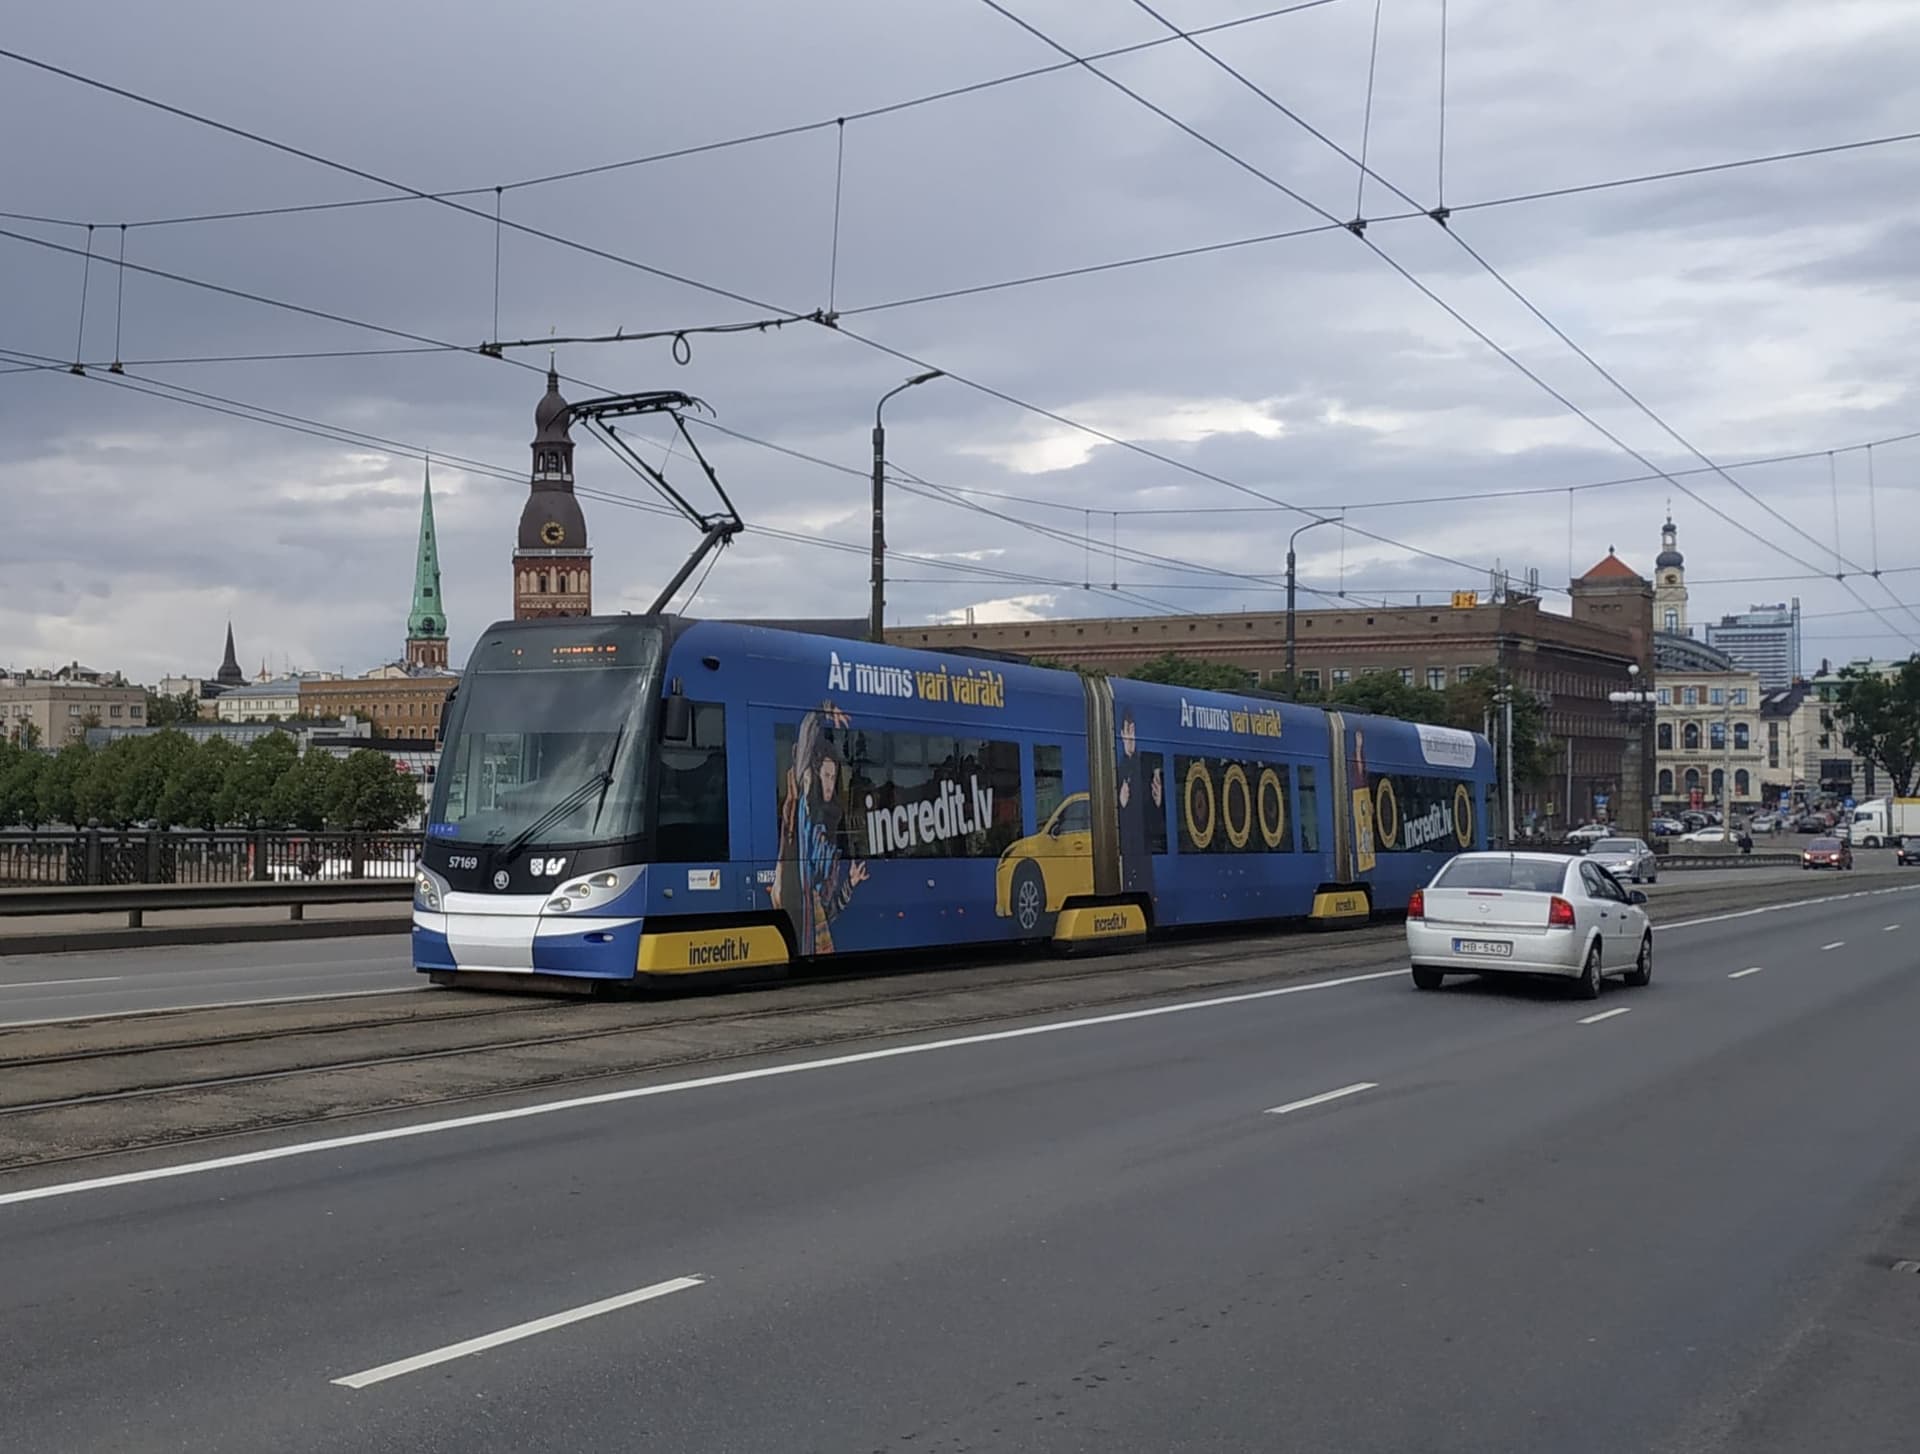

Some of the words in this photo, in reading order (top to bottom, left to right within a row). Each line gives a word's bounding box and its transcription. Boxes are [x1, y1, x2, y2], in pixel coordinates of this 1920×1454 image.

[828, 651, 852, 692] Ar
[855, 663, 914, 699] mums
[915, 664, 950, 702] vari
[951, 668, 1005, 708] vairāk!
[1180, 697, 1194, 728] Ar
[1195, 706, 1230, 732] mums
[1230, 705, 1249, 735] vari
[865, 774, 993, 855] incredit.lv
[1403, 800, 1453, 849] incredit.lv
[448, 856, 478, 869] 57169
[1094, 911, 1128, 932] incredit.lv
[689, 936, 750, 966] incredit.lv
